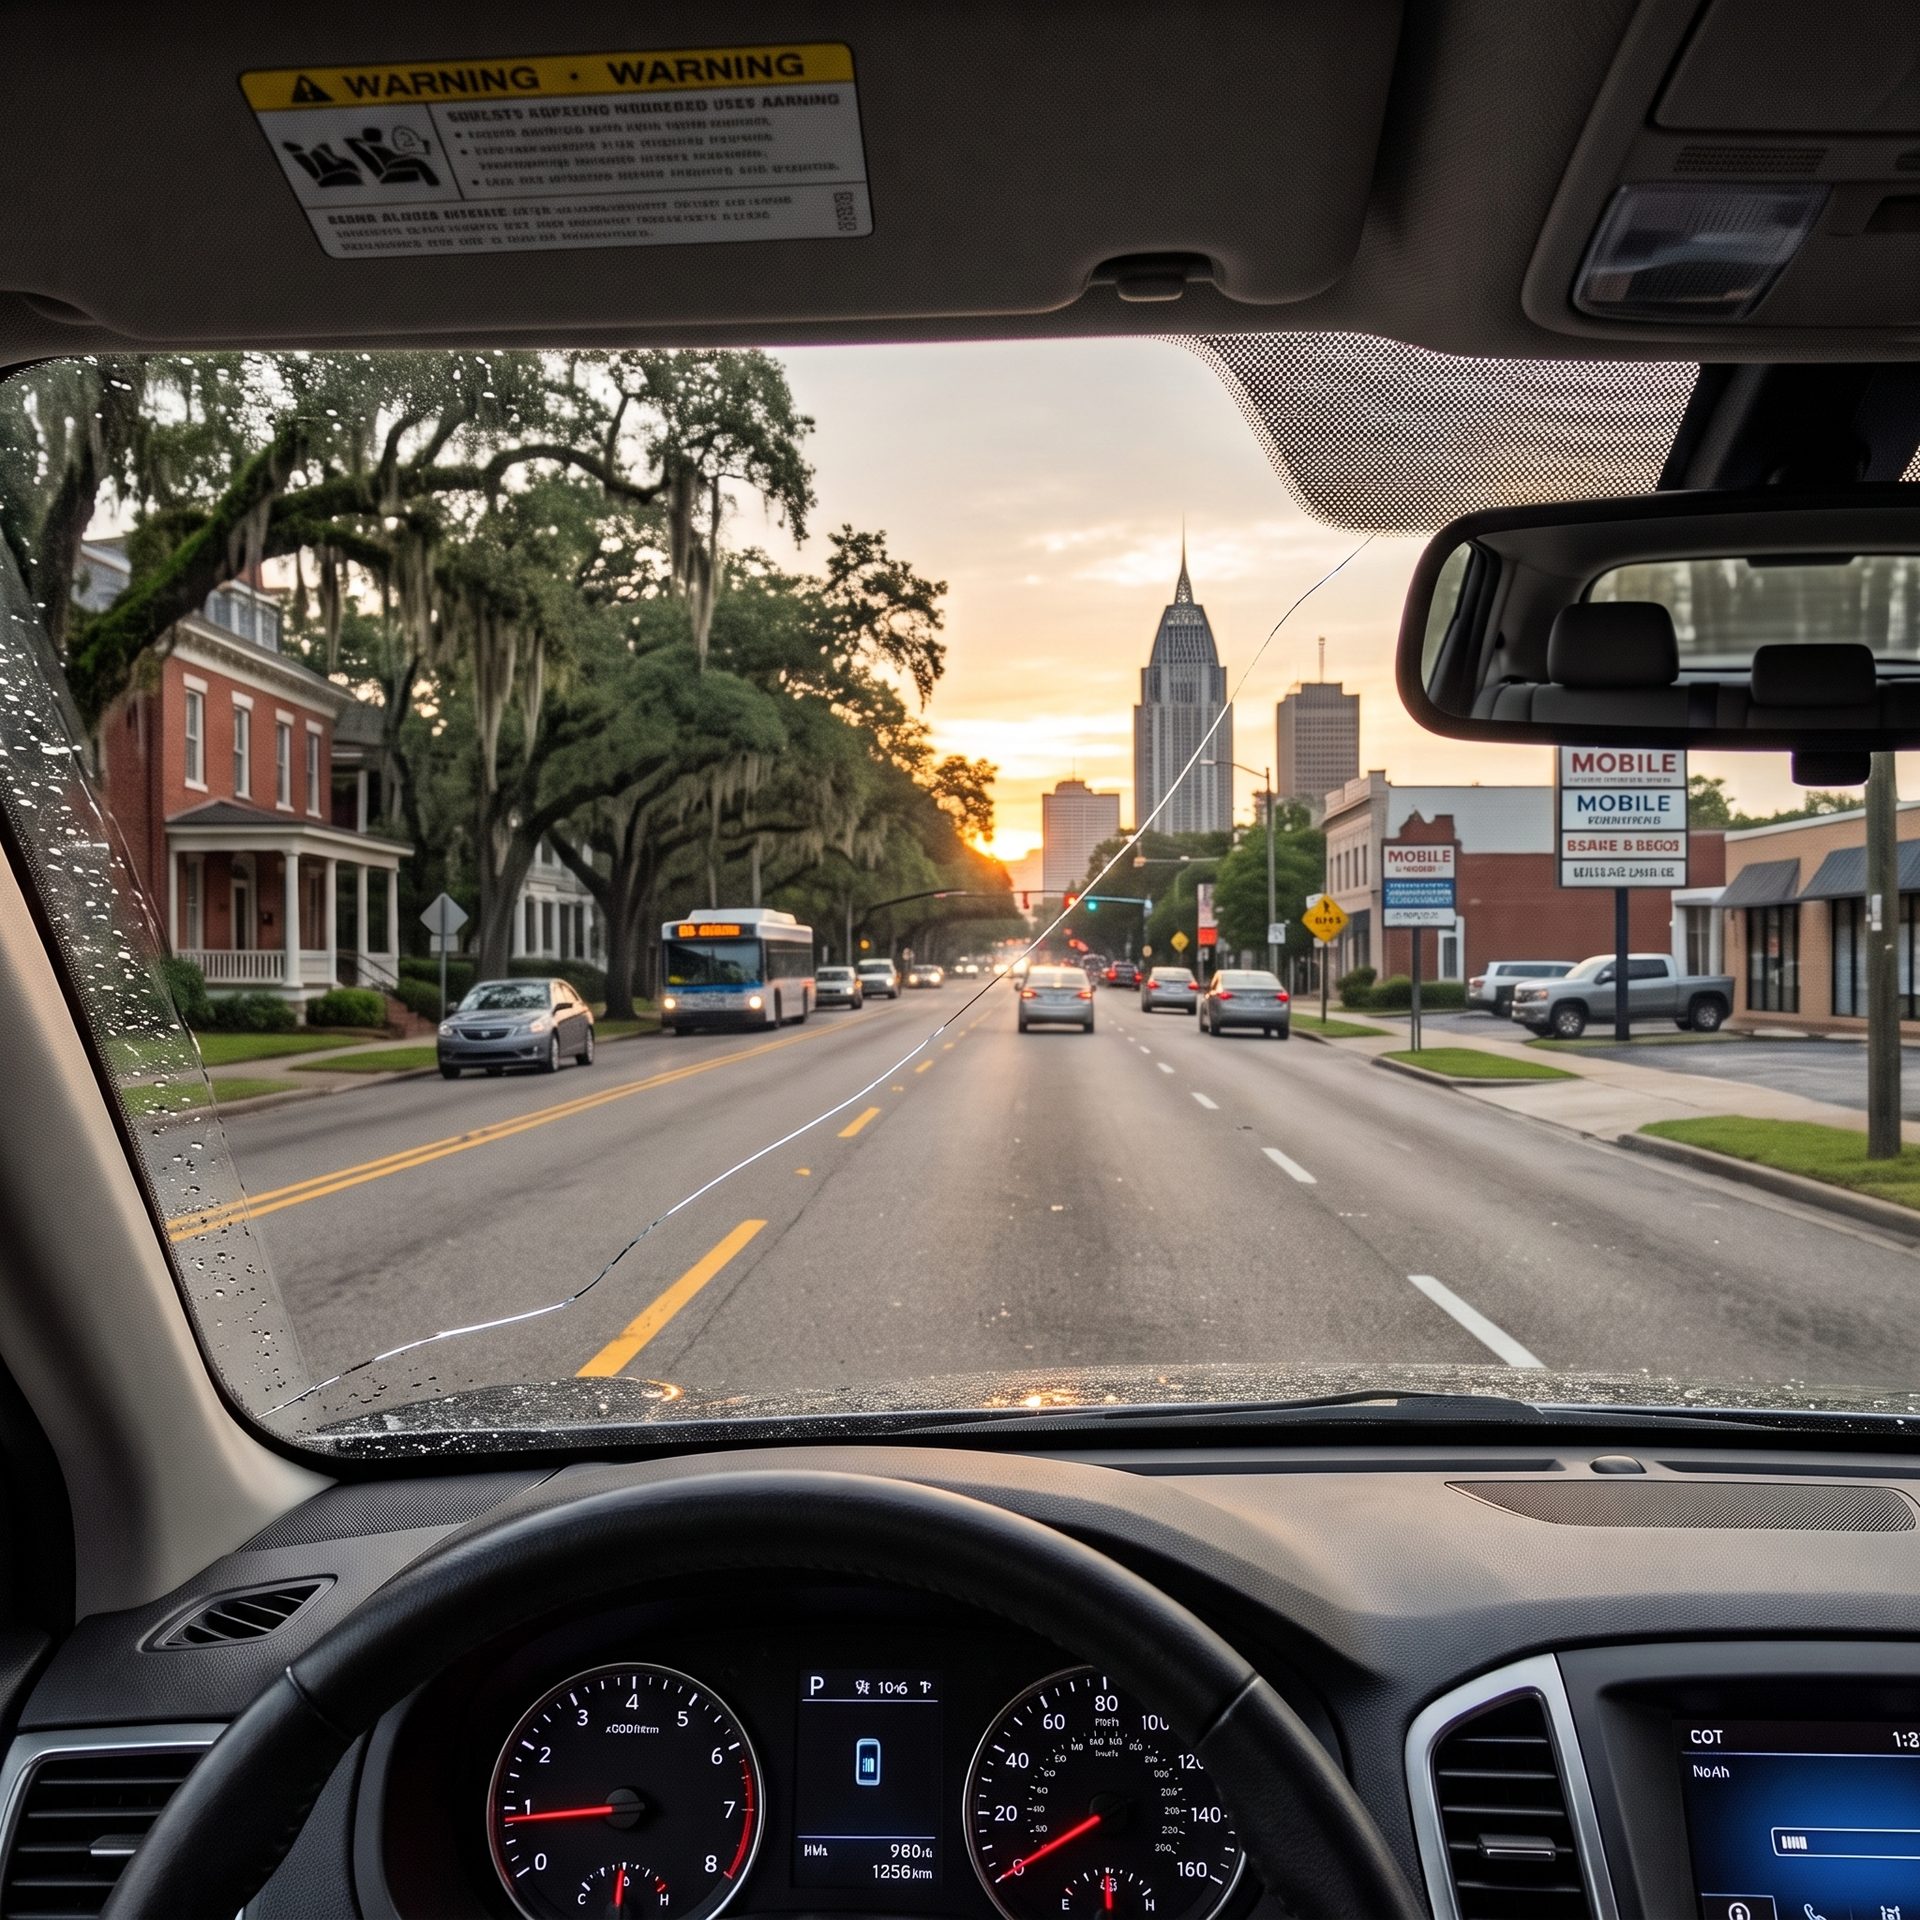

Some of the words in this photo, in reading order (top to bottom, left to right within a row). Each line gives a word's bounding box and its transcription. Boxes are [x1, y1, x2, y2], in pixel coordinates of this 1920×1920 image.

[342, 65, 541, 99] WARNING
[606, 52, 805, 86] WARNING
[1572, 752, 1677, 773] MOBILE
[1577, 795, 1671, 812] MOBILE
[1388, 850, 1451, 863] MOBILE
[810, 1675, 824, 1696] P
[625, 1694, 639, 1710] 4
[1094, 1695, 1119, 1712] 80
[576, 1709, 589, 1727] 3
[676, 1711, 689, 1727] 5
[1043, 1714, 1065, 1730] 60
[1690, 1729, 1723, 1744] COT
[1892, 1731, 1920, 1748] 1:8
[538, 1747, 551, 1763] 2
[711, 1747, 723, 1765] 6
[1005, 1752, 1029, 1769] 40
[1693, 1764, 1730, 1778] NoAh
[524, 1800, 531, 1815] 1
[723, 1801, 736, 1819] 7
[994, 1805, 1018, 1822] 20
[1191, 1806, 1221, 1823] 140
[534, 1853, 547, 1870] 0
[704, 1855, 717, 1872] 8
[1012, 1858, 1025, 1877] 0
[1177, 1862, 1207, 1878] 160
[577, 1894, 586, 1905] C
[660, 1895, 669, 1906] H
[1061, 1900, 1070, 1911] E
[1145, 1899, 1155, 1911] H
